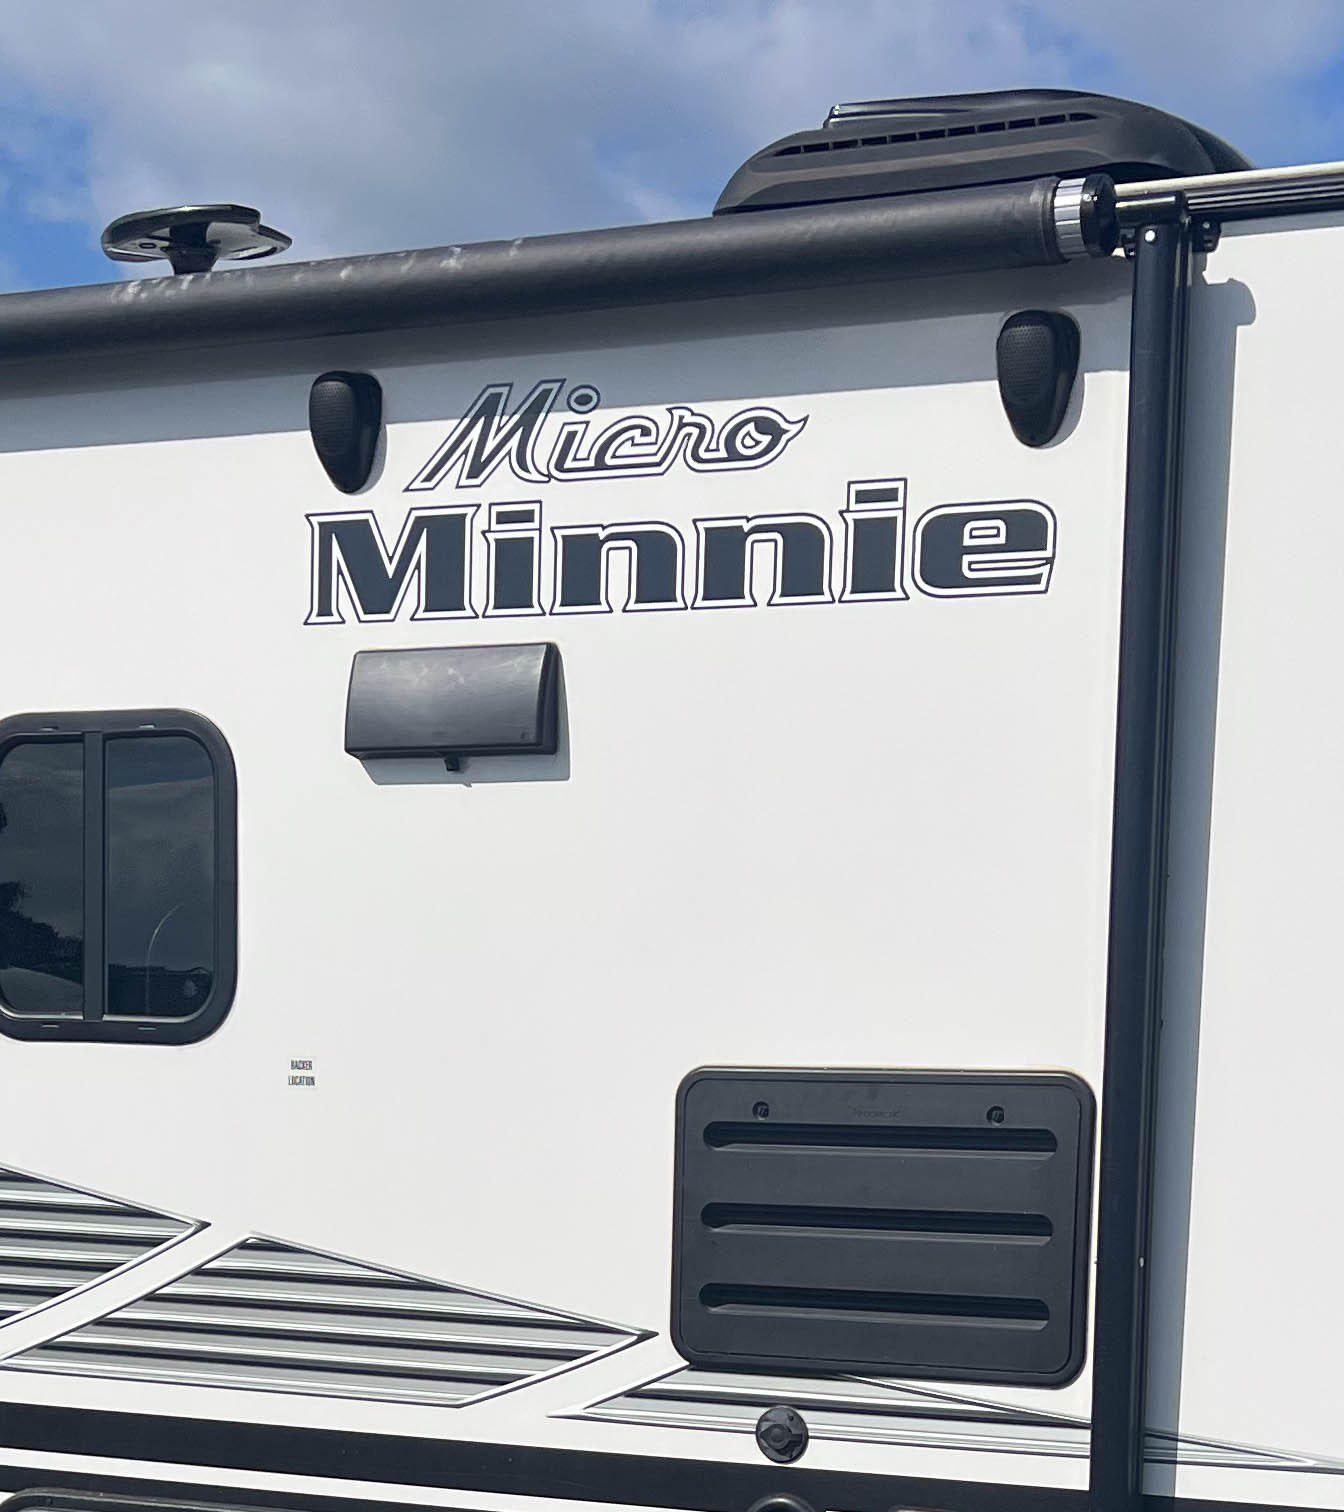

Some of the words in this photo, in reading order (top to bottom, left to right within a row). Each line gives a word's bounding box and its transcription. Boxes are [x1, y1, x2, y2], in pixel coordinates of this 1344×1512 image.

[403, 378, 808, 492] Micro
[304, 477, 1055, 625] Minnie
[287, 1075, 316, 1086] LOCATION
